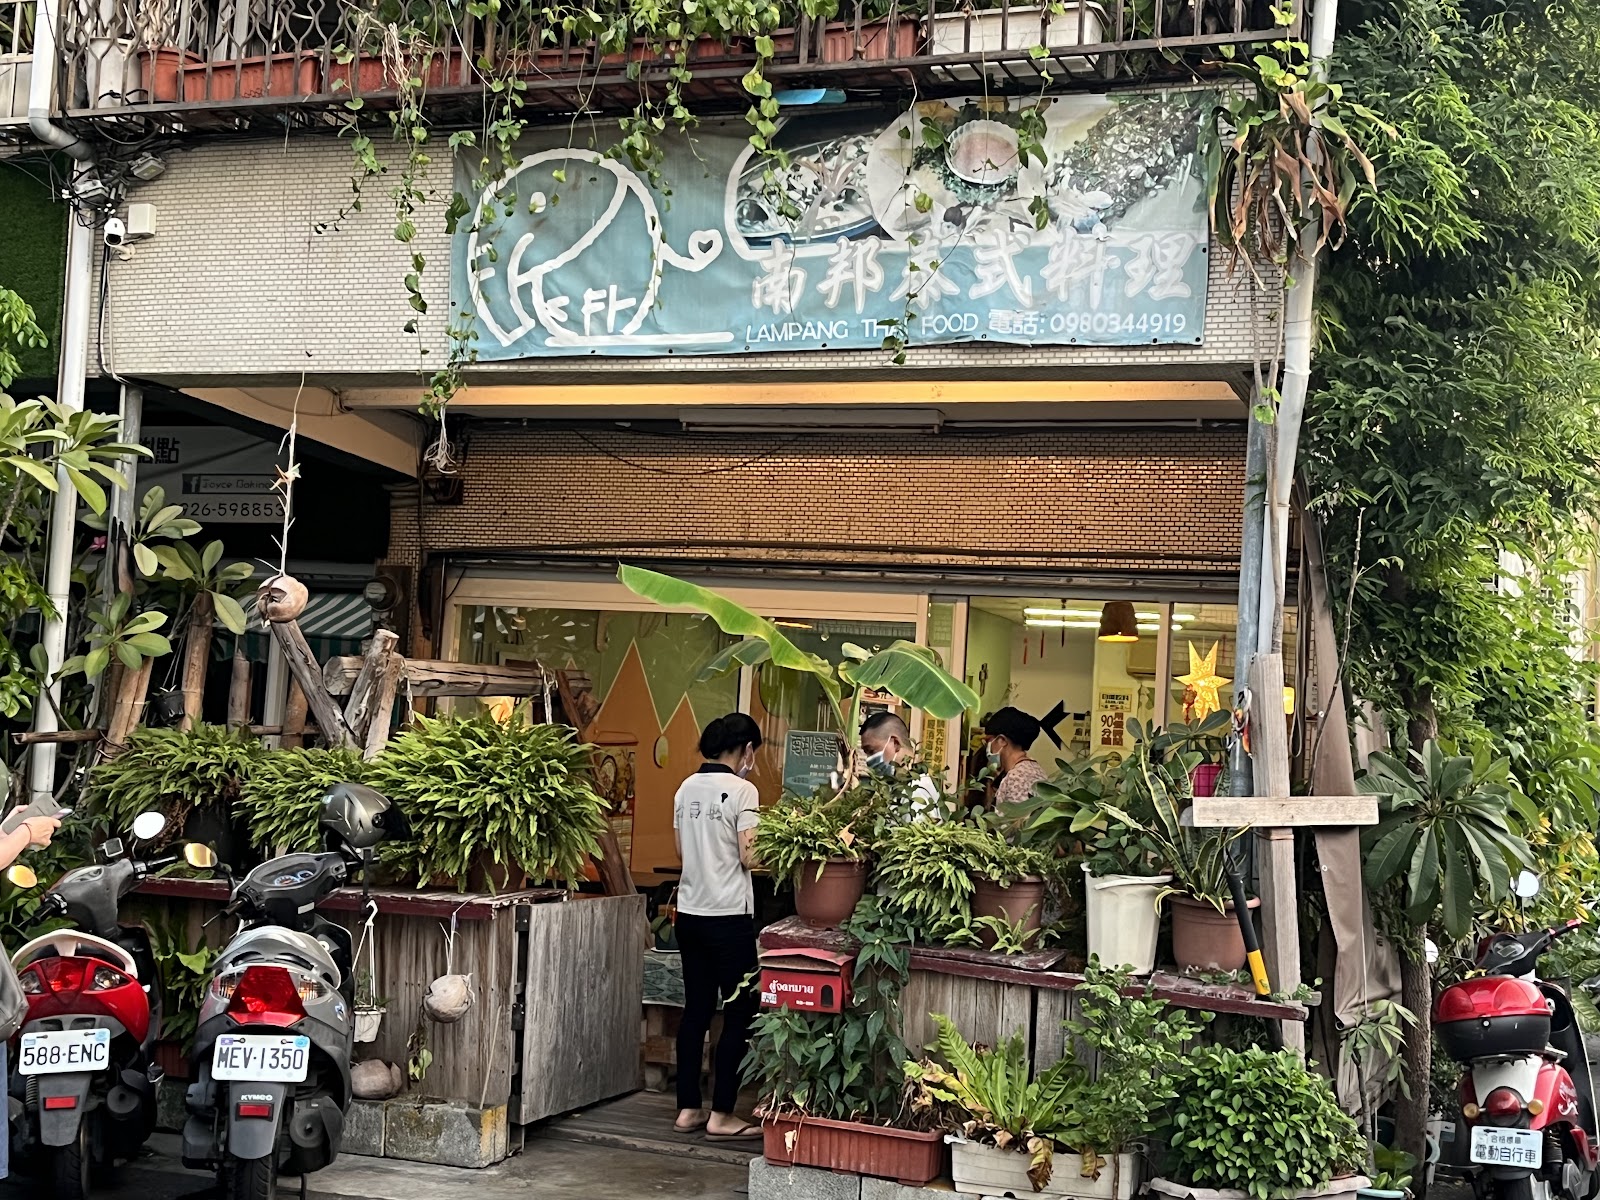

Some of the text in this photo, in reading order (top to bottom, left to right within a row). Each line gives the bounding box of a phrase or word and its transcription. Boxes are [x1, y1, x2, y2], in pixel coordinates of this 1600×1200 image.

[751, 223, 1197, 315] 南邦泰式料理
[745, 319, 849, 343] LAMPANG
[921, 313, 979, 335] FOOD
[1050, 312, 1187, 334] 0980344919
[170, 502, 286, 517] 926-598853
[23, 1043, 106, 1066] 588-ENC
[216, 1046, 304, 1070] MEV-1350
[1475, 1144, 1537, 1165] 電動自行車
